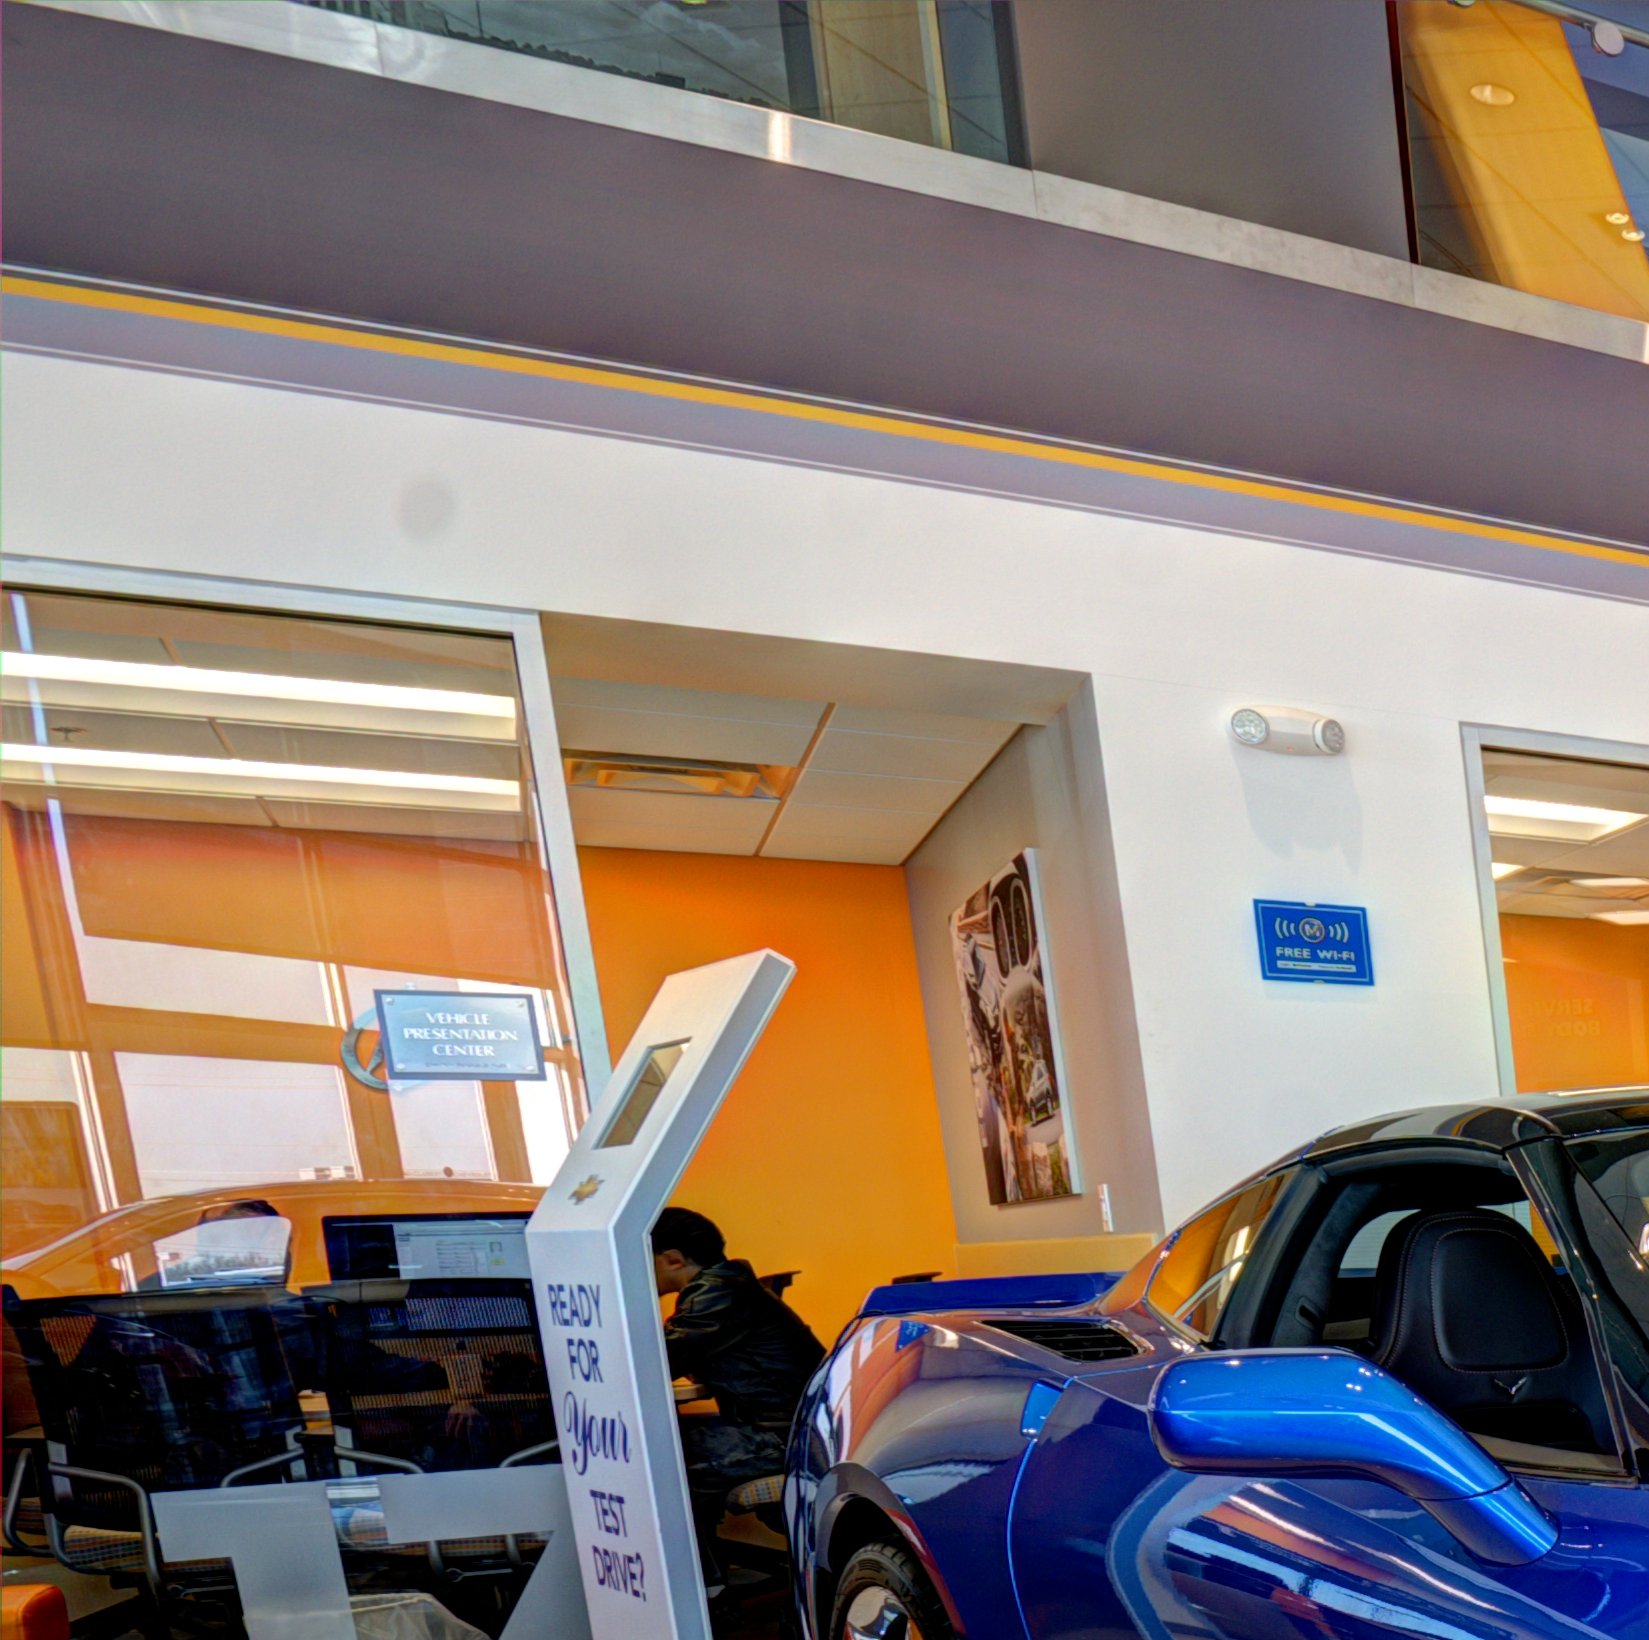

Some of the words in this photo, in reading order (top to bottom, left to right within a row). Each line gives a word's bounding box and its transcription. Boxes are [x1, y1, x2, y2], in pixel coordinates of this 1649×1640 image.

[1275, 946, 1312, 959] FREE
[1316, 949, 1356, 961] WI-FI
[403, 1027, 519, 1040] PRESENTATION
[425, 1012, 491, 1025] VEHICLE
[432, 1044, 496, 1057] CENTER
[547, 1283, 603, 1328] READY
[566, 1338, 603, 1383] FOR
[563, 1390, 632, 1476] Your
[589, 1489, 628, 1538] TEST
[592, 1544, 647, 1602] DRIVE?
